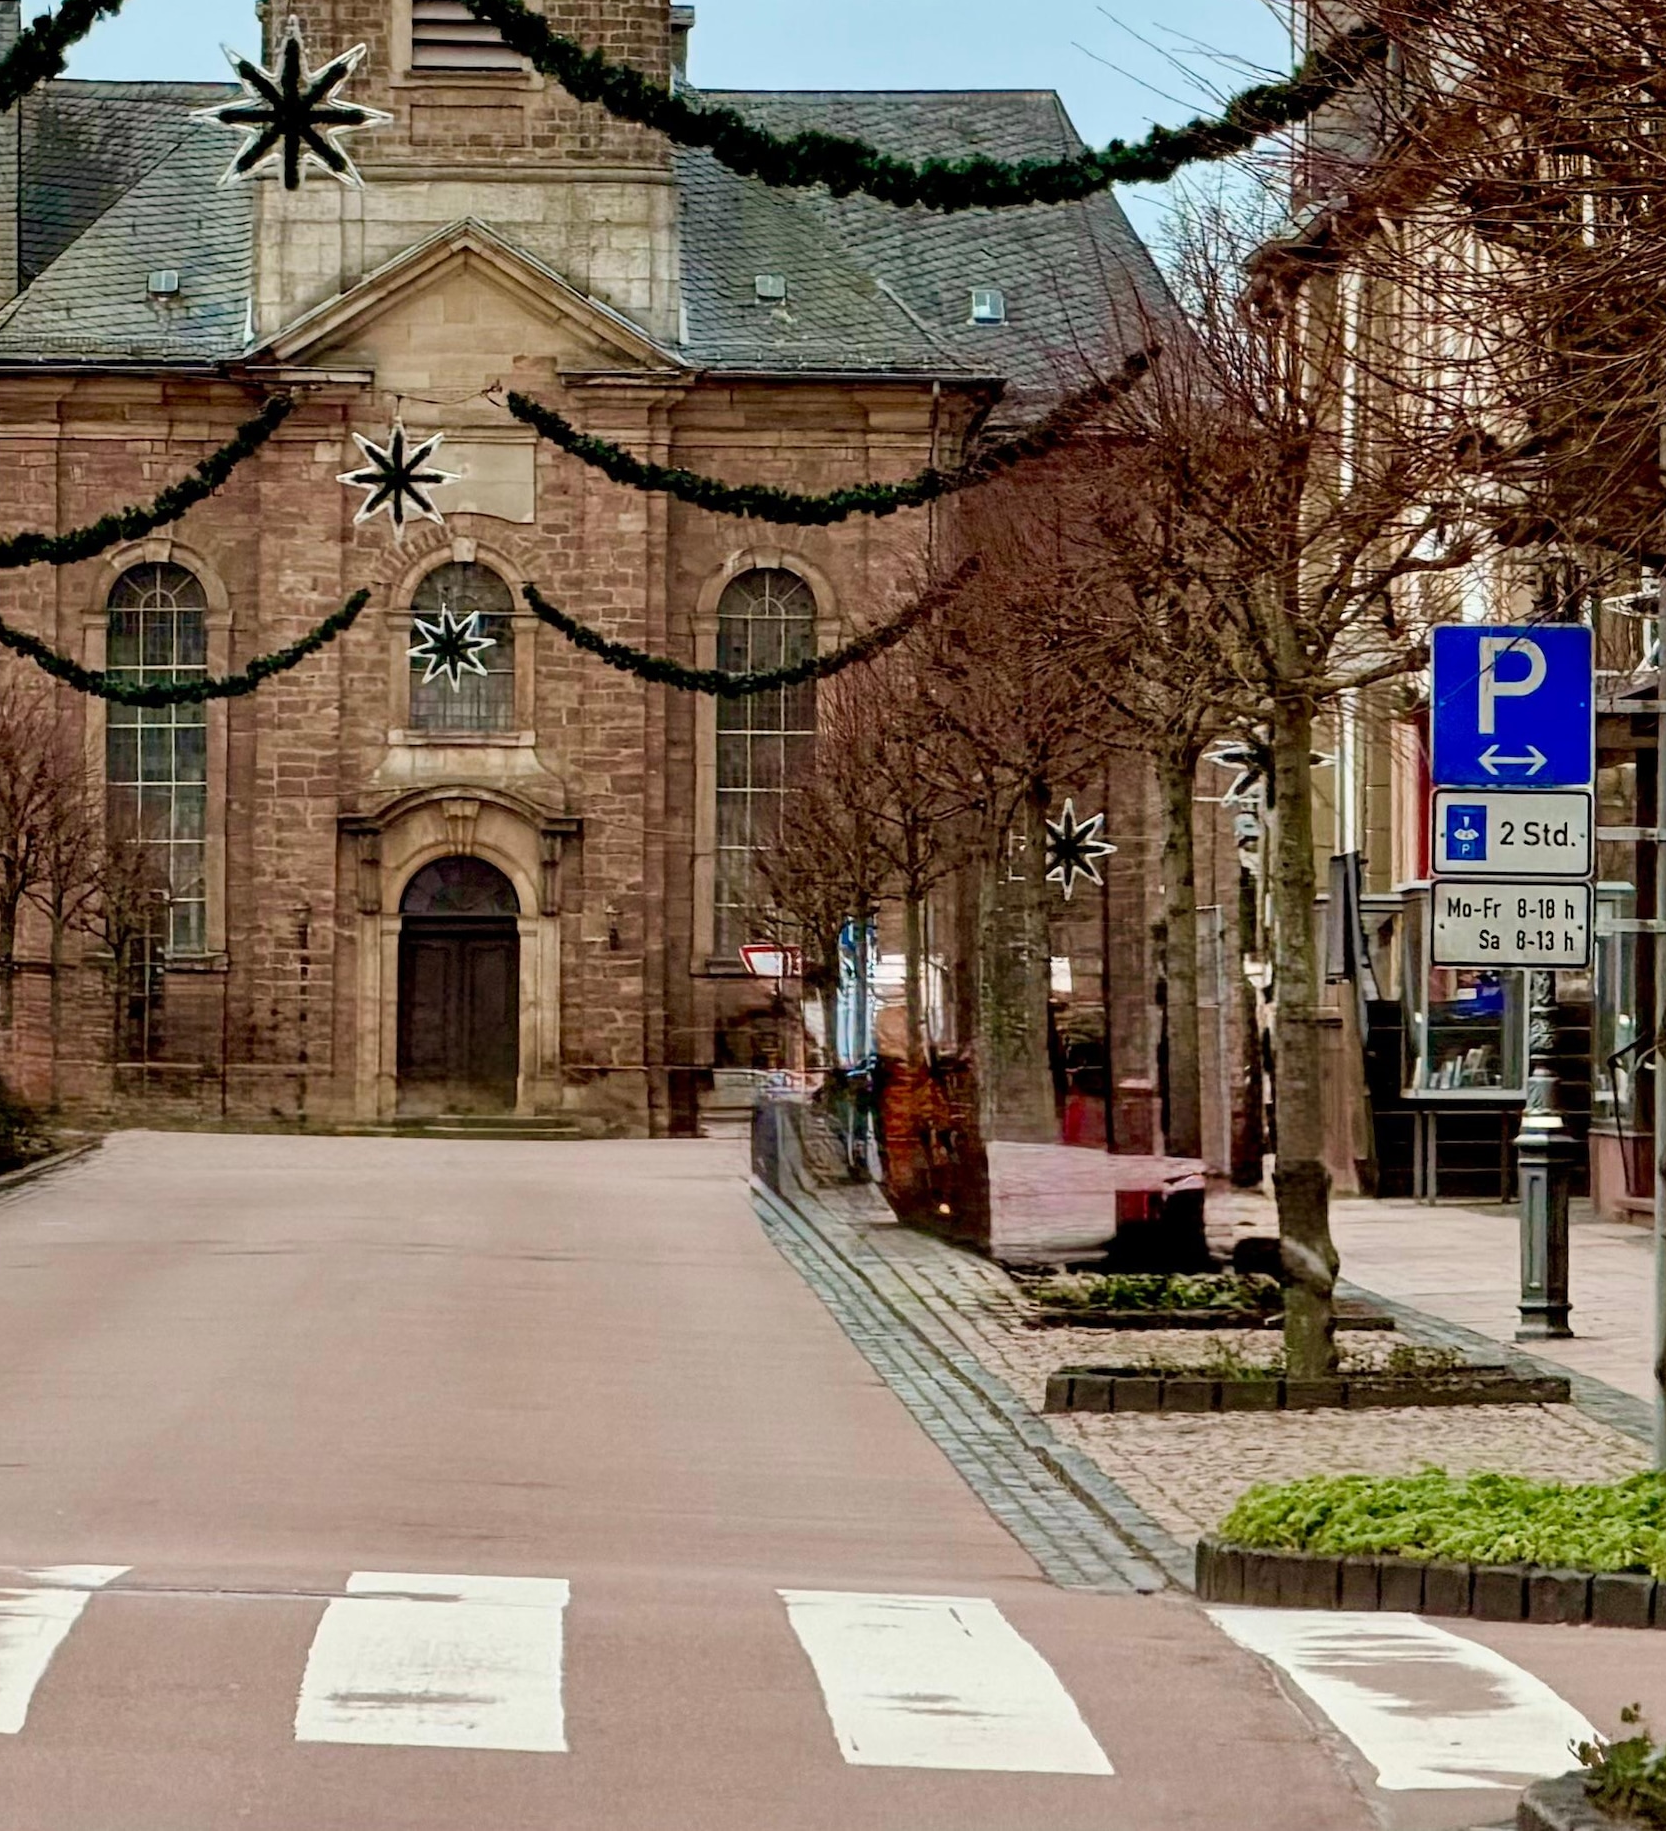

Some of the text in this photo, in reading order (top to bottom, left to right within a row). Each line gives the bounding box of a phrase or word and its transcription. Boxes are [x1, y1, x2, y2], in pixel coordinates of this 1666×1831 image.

[1478, 636, 1547, 735] P
[1499, 821, 1576, 847] 2 Std.
[1447, 897, 1574, 920] Mo-Fr 8-18 h
[1479, 929, 1574, 952] Sa 8-13 h
